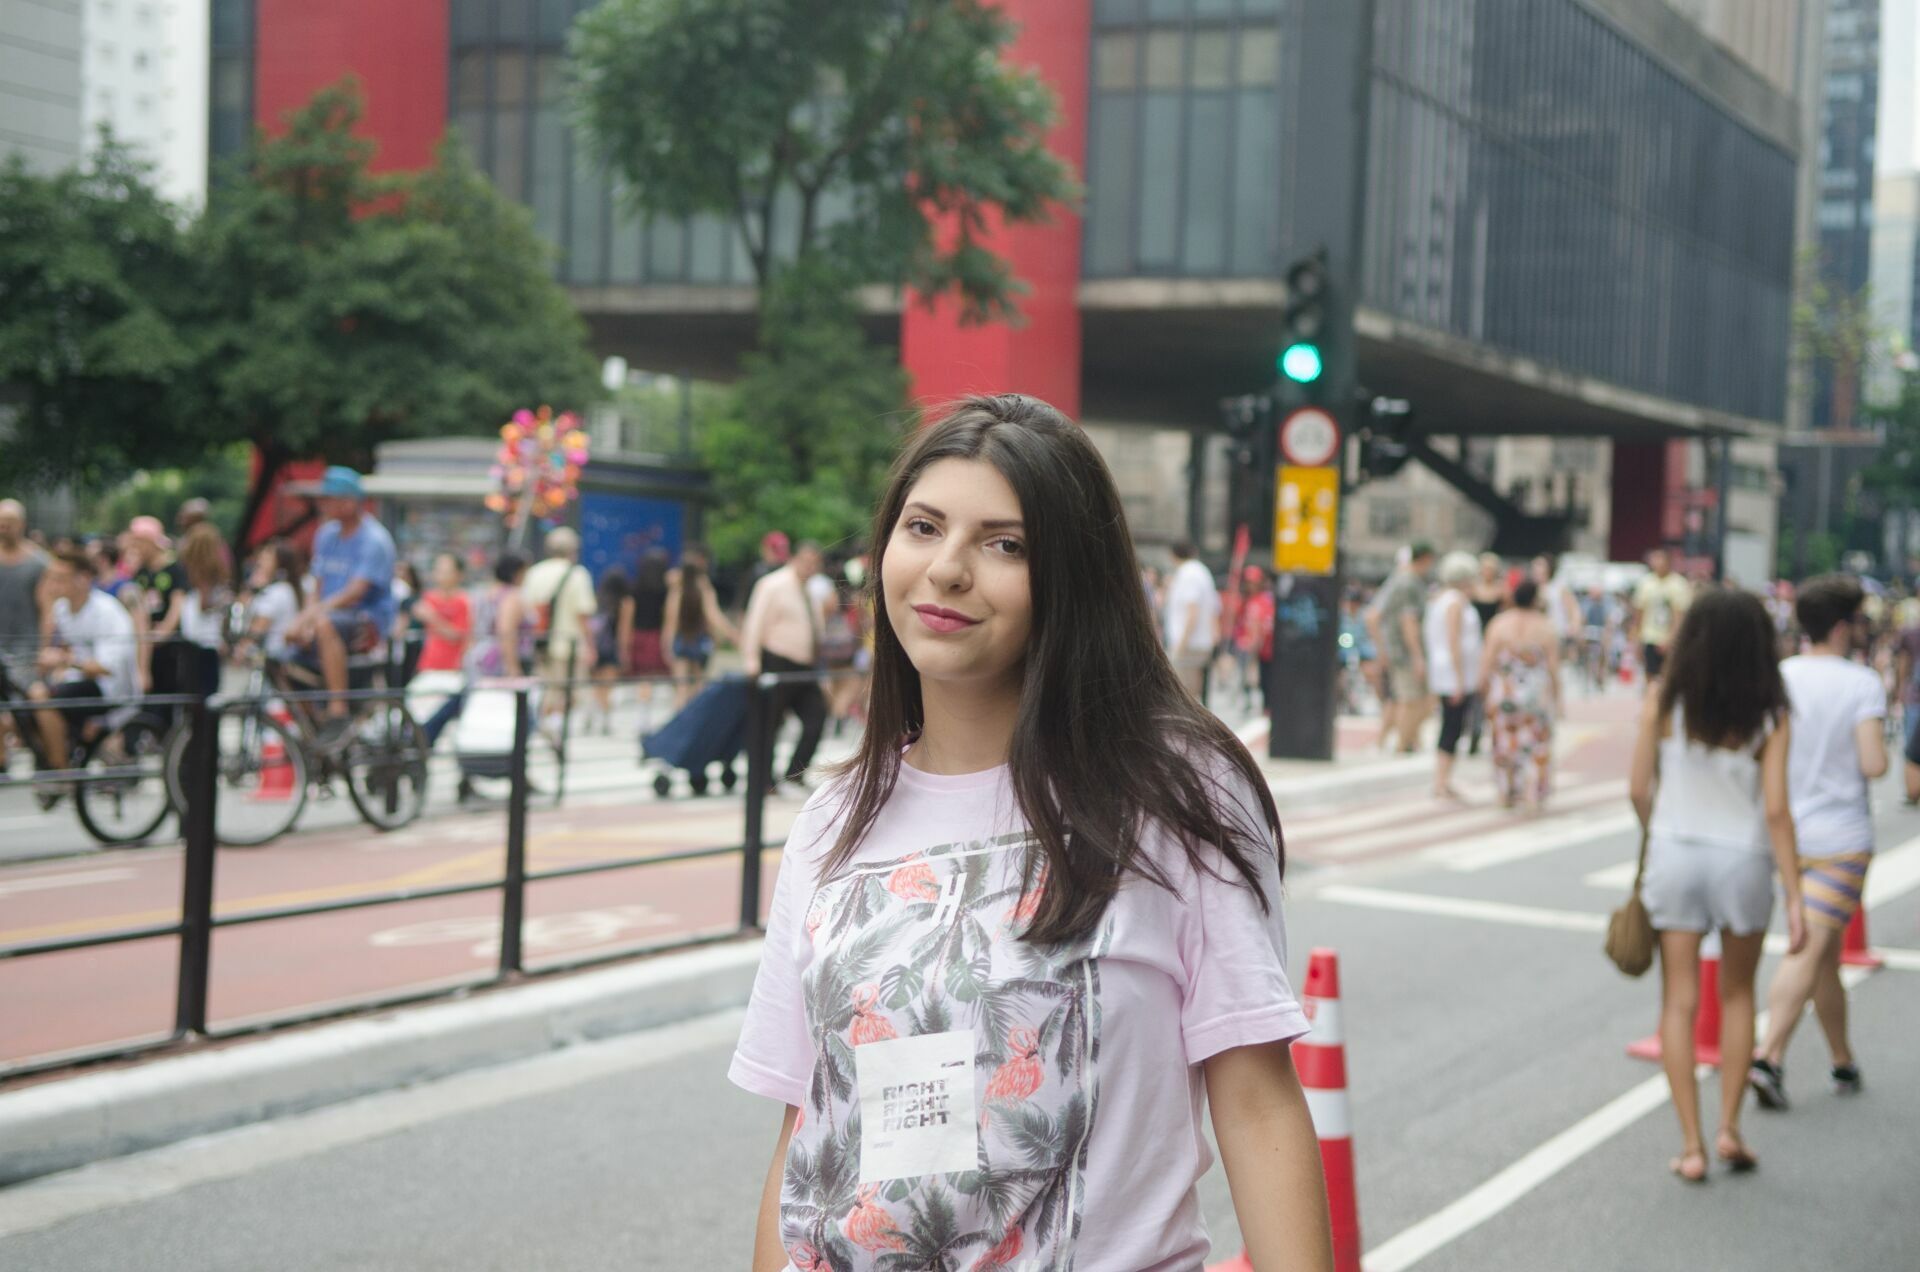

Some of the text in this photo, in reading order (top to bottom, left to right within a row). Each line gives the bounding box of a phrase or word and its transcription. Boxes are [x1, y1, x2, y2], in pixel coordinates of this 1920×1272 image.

[883, 1078, 948, 1101] RIGHT
[883, 1095, 949, 1118] RIGHT
[882, 1110, 951, 1133] RIGHT
